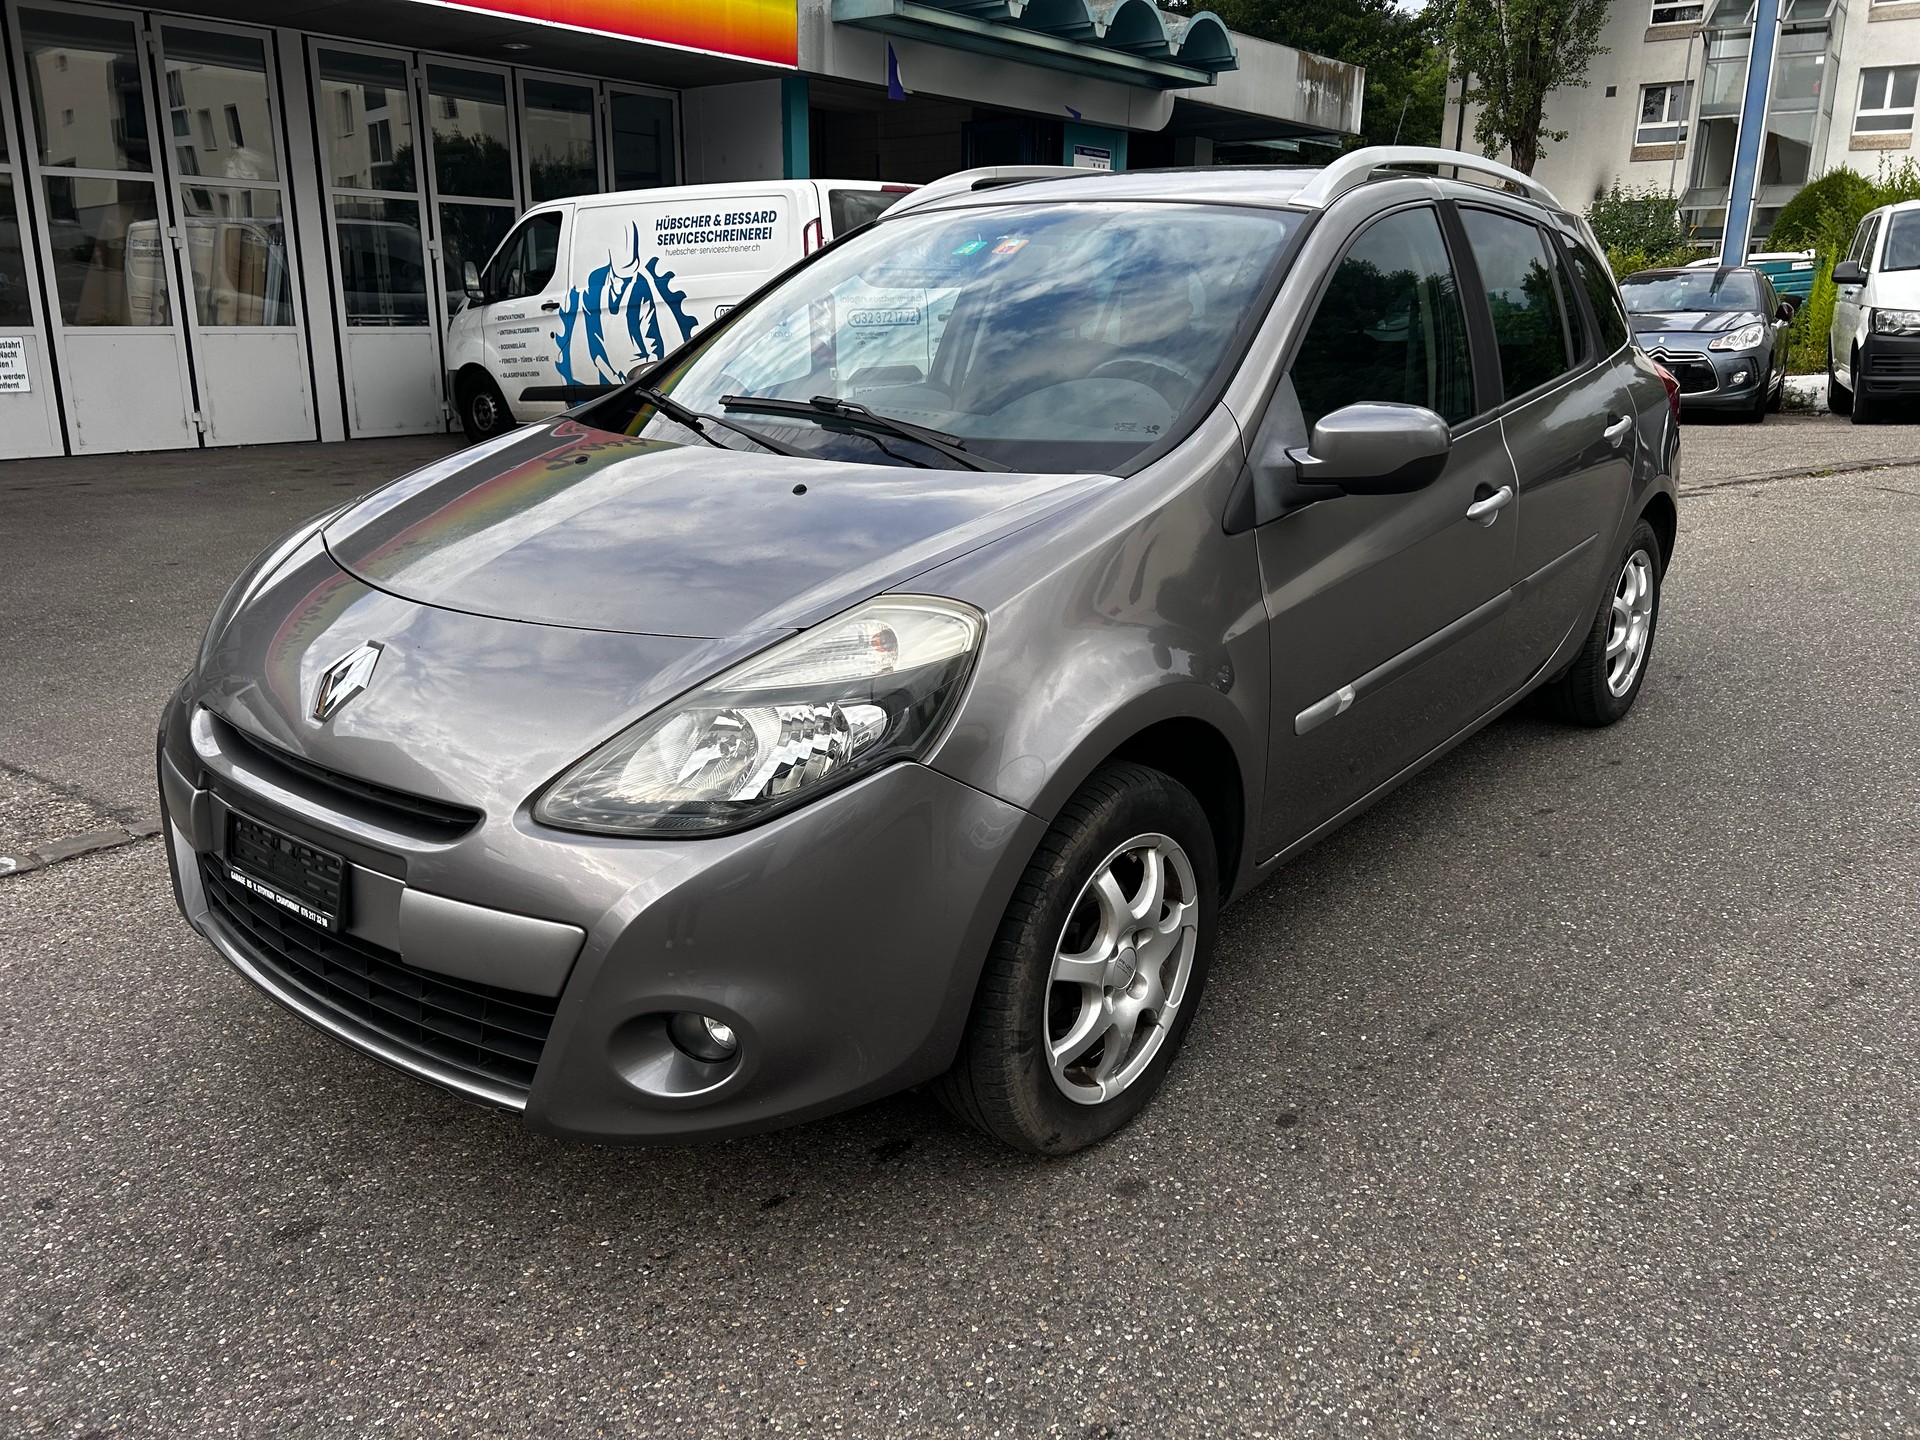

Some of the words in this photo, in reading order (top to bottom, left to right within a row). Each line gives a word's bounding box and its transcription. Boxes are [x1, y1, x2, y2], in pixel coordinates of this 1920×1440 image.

[655, 215, 712, 231] HÜBSCHER
[713, 214, 721, 226] &
[724, 210, 777, 226] BESSARD
[657, 227, 773, 246] SERVICESCHREINEREI
[665, 244, 761, 256] huebscher-serviceschreiner.ch
[497, 313, 526, 321] RENOVATIONEN
[876, 311, 893, 323] 372
[230, 870, 246, 886] GARAGE
